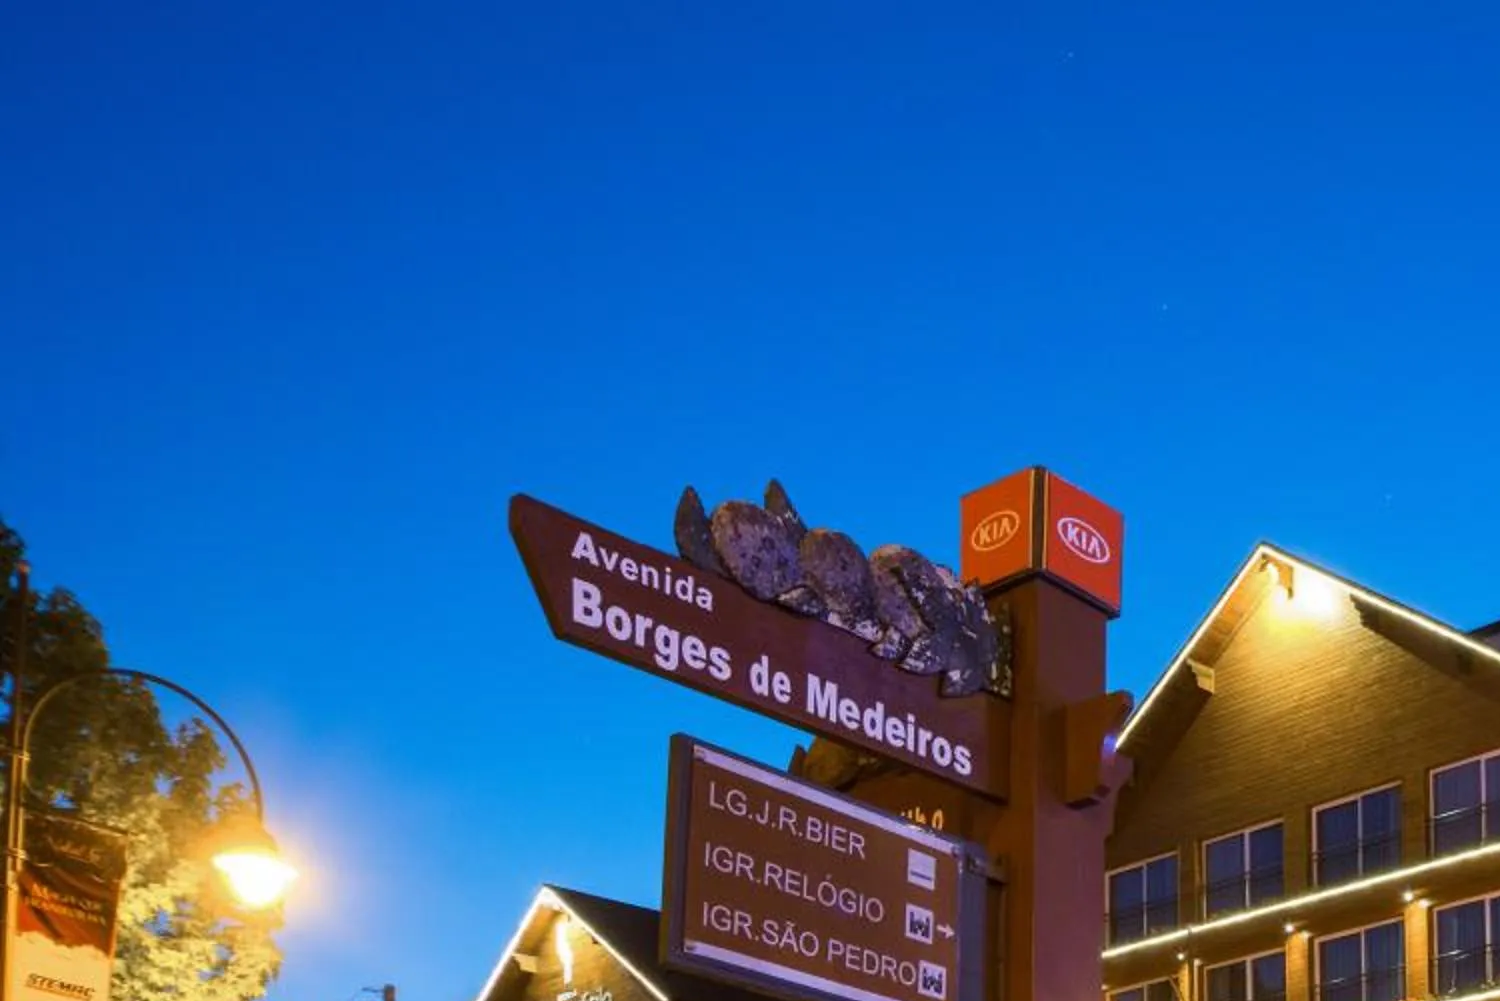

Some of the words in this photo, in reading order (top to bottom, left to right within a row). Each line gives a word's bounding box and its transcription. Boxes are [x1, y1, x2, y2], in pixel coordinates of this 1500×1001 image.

[571, 531, 713, 612] Avenida
[977, 515, 1014, 547] KIA
[1064, 520, 1103, 560] KIA
[572, 577, 732, 682] Borges
[749, 654, 792, 704] de
[805, 671, 973, 777] Medeiros
[708, 780, 866, 860] LG.J.R.BIER
[703, 841, 885, 923] IGR.RELÓGIO
[702, 900, 820, 957] IGR.SÃO
[826, 937, 917, 986] PEDRO
